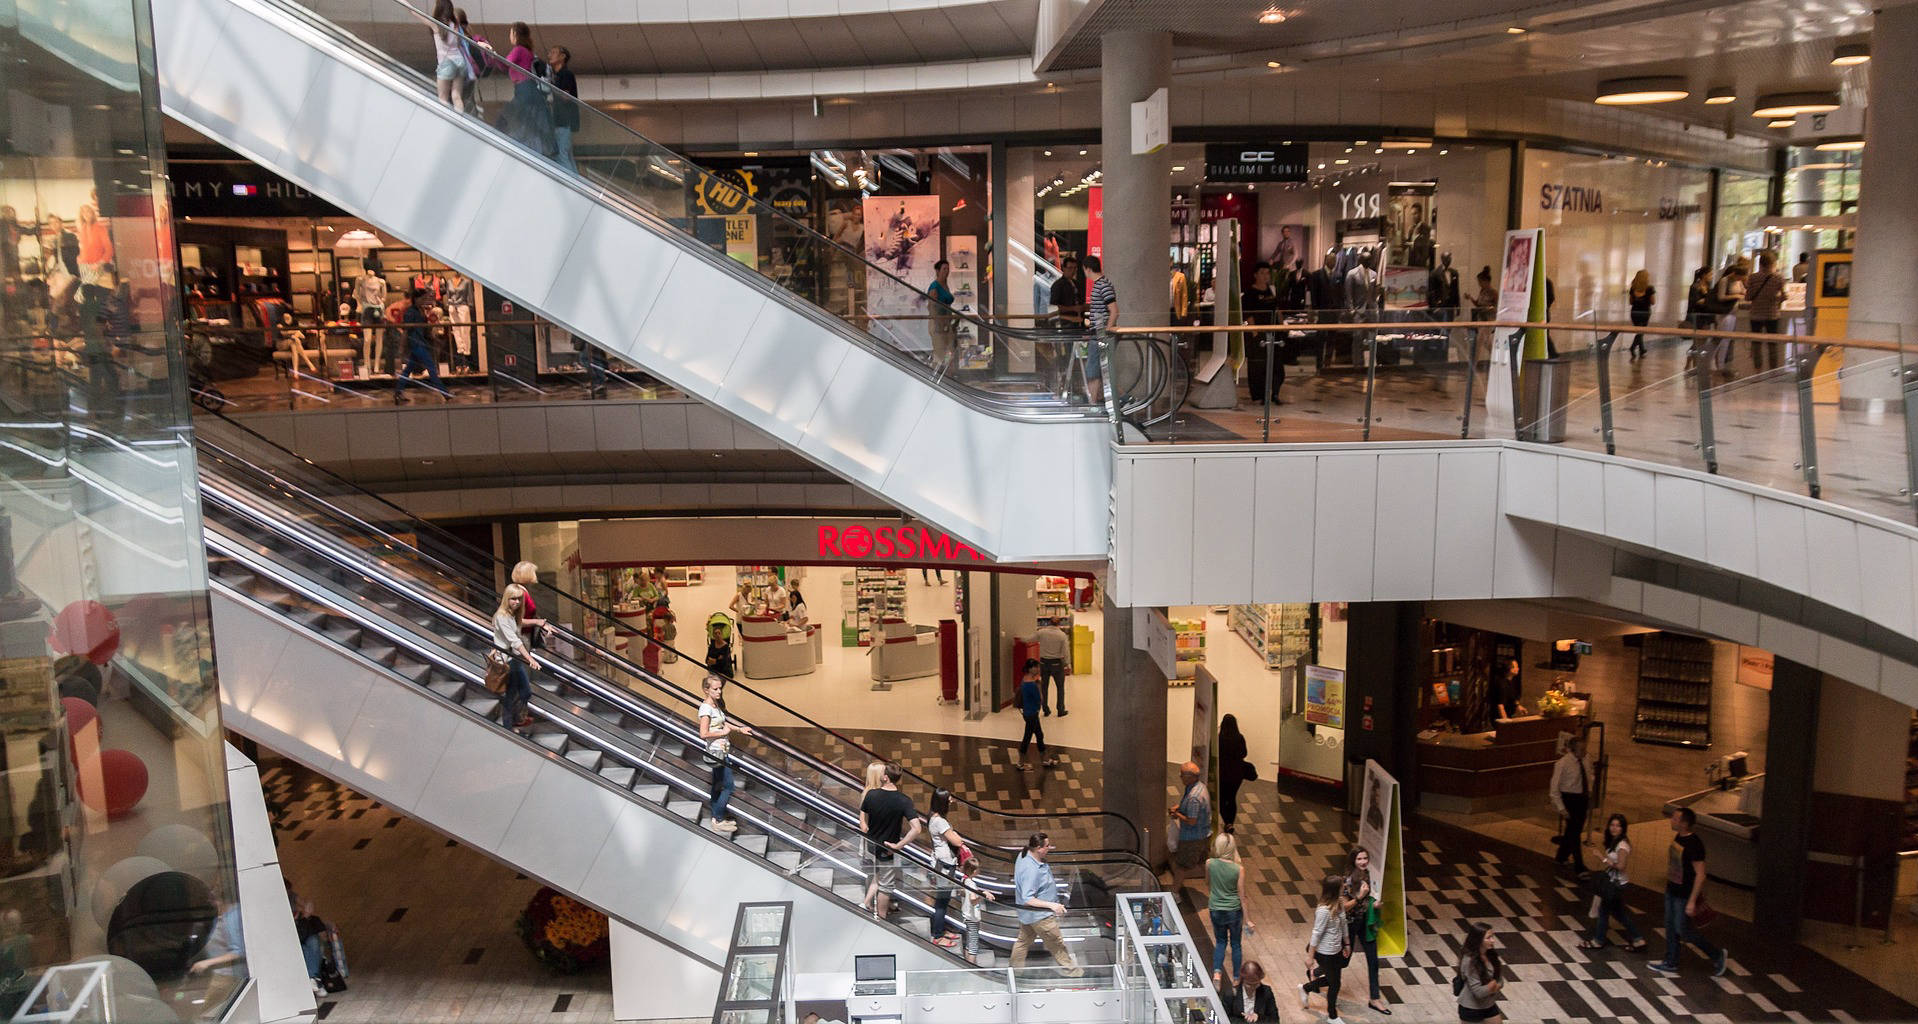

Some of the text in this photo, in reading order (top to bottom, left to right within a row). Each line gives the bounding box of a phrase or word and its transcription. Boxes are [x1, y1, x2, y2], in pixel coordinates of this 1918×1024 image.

[266, 181, 312, 198] HIL
[1541, 183, 1602, 213] SZATNIA
[818, 525, 986, 561] ROSSMA
